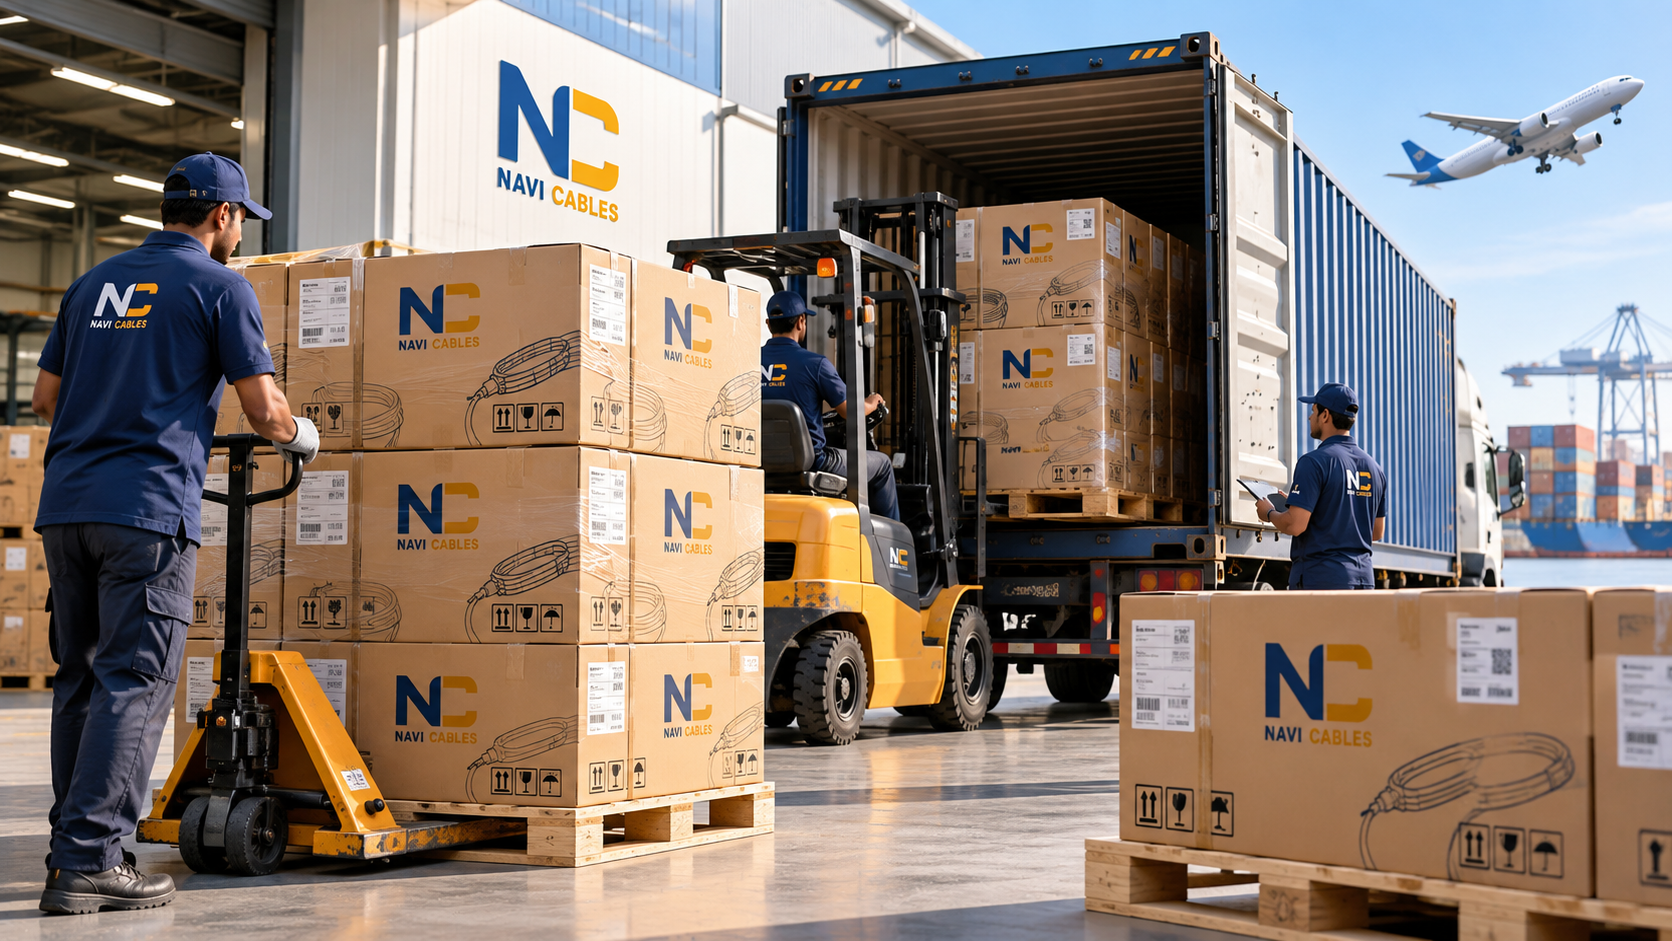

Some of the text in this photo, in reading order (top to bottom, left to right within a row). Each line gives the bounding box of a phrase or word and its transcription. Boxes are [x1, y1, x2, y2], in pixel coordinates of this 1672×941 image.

[498, 60, 620, 192] NC
[497, 166, 619, 222] NAVI CABLES
[1002, 223, 1053, 255] NC
[1002, 255, 1053, 266] NAVI CABLES
[93, 282, 159, 317] NC
[399, 282, 481, 335] NC
[90, 320, 147, 329] NAVI CABLES
[665, 297, 712, 354] NC
[398, 336, 480, 351] NAVI CABLES
[664, 349, 713, 369] NAVI CABLES
[1002, 348, 1054, 379] NC
[1024, 380, 1053, 389] CABLES
[1346, 469, 1371, 491] NC
[397, 482, 480, 534] NC
[664, 488, 713, 540] NC
[397, 538, 479, 550] NAVI CABLES
[664, 542, 713, 555] NAVI CABLES
[890, 546, 908, 566] NC
[1265, 642, 1373, 723] NC
[396, 675, 478, 728] NC
[664, 672, 712, 723] NC
[395, 731, 478, 744] NAVI CABLES
[664, 724, 713, 739] NAVI CABLES
[1264, 725, 1372, 748] NAVI CABLES
